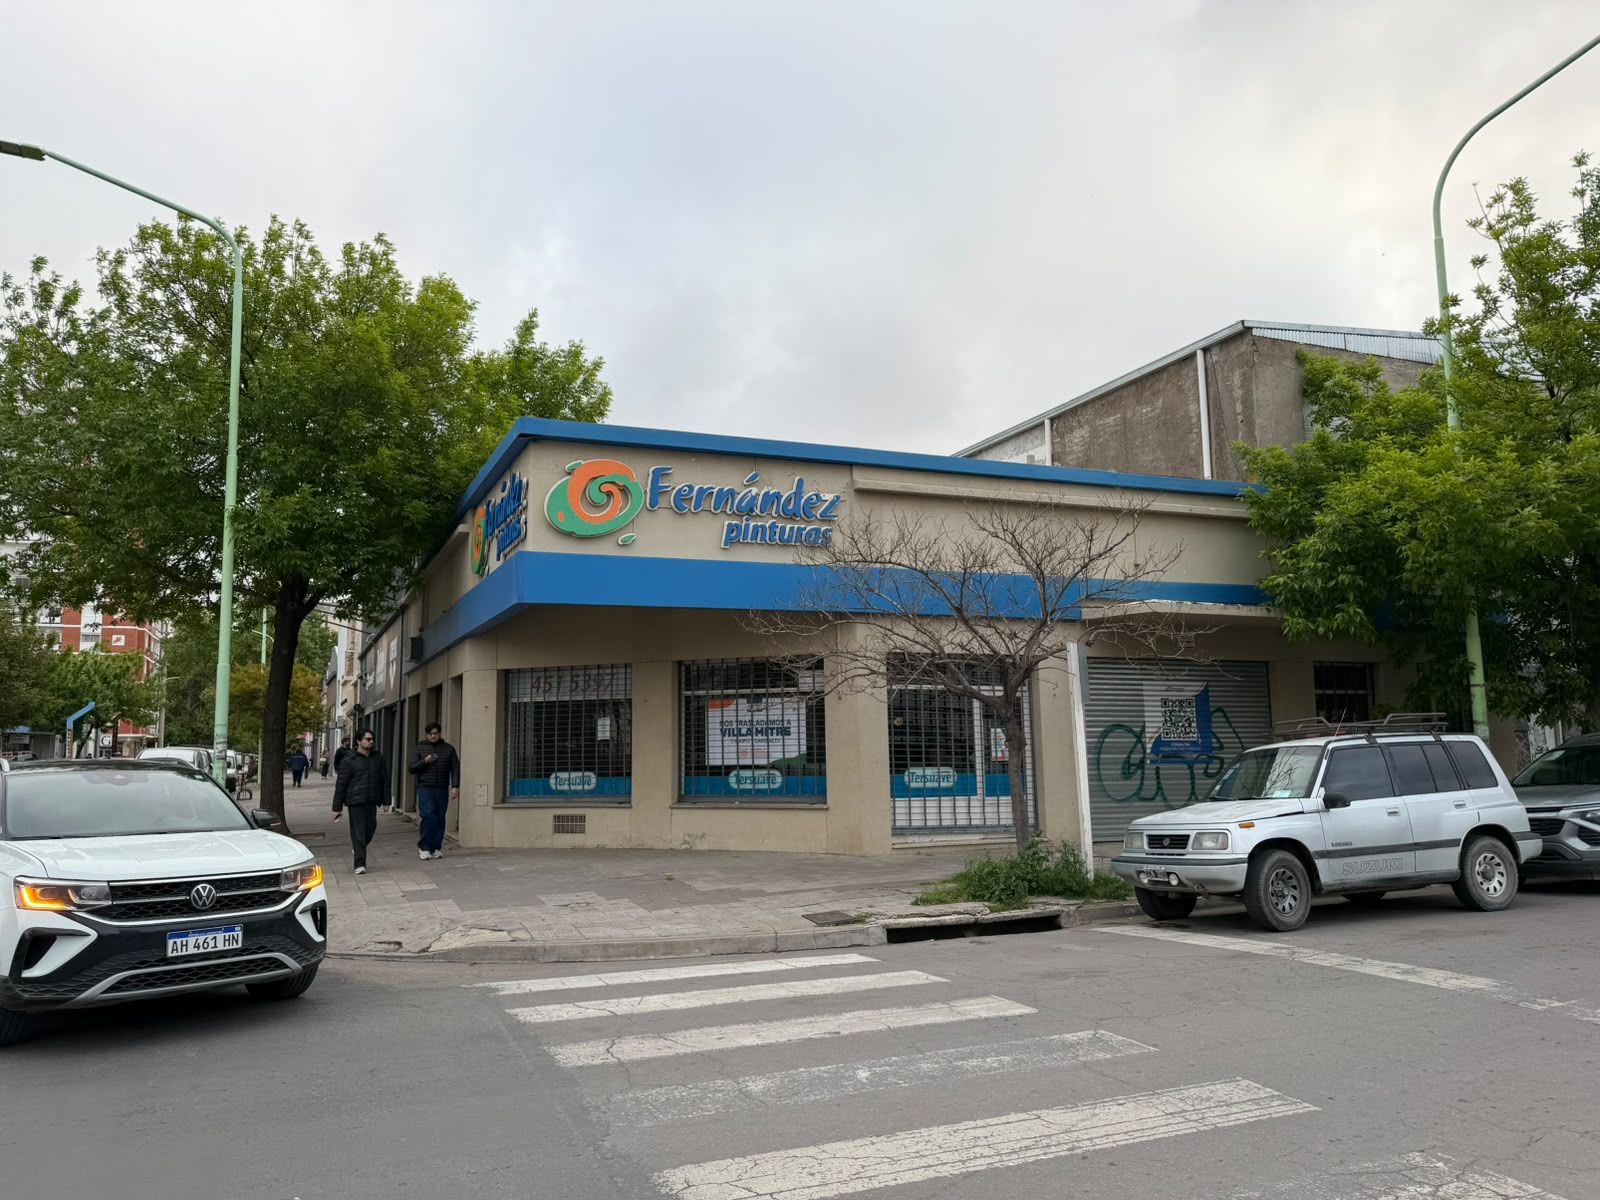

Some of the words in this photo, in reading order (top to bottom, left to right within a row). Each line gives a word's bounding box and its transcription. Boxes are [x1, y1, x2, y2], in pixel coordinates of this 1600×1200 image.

[646, 465, 843, 521] Fernández
[721, 515, 833, 550] pinturas
[720, 727, 752, 738] VILLA
[754, 726, 792, 737] MITRE
[908, 771, 952, 784] Tersuave
[1342, 857, 1403, 876] SUZUKI
[171, 940, 188, 954] AH
[193, 935, 218, 951] 461
[223, 933, 239, 948] HN
